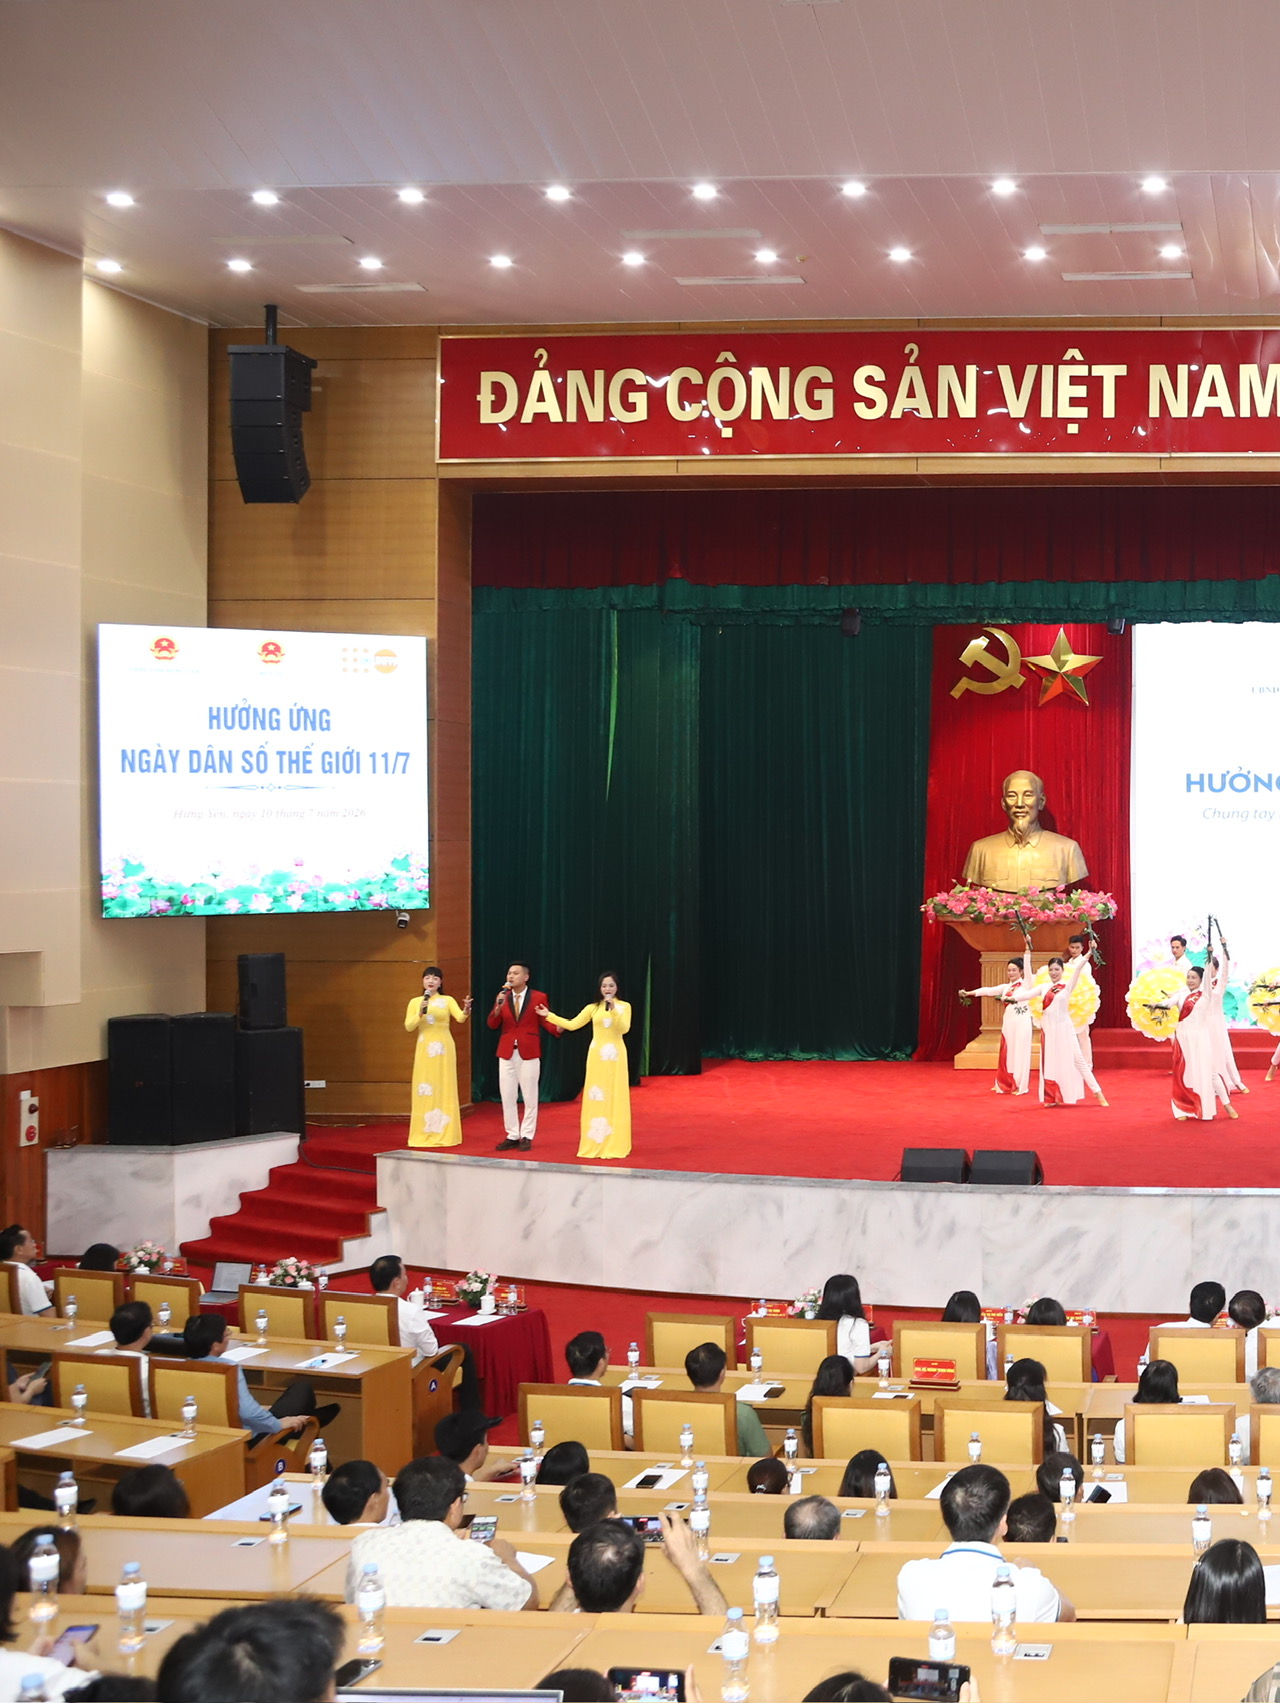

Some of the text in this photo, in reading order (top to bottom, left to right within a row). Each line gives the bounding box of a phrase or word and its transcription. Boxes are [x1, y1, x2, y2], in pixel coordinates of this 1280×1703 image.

[476, 347, 649, 425] ĐẢNG
[664, 351, 835, 439] CỘNG
[853, 342, 977, 420] SẢN
[996, 348, 1127, 434] VIỆT
[208, 697, 332, 732] HƯỞNG ỨNG
[120, 740, 411, 776] NGÀY DÂN SỐ THẾ GIỚI 11/7
[261, 808, 273, 818] 10
[342, 808, 366, 818] 2026
[1202, 807, 1249, 823] Chung
[1253, 809, 1275, 822] tay
